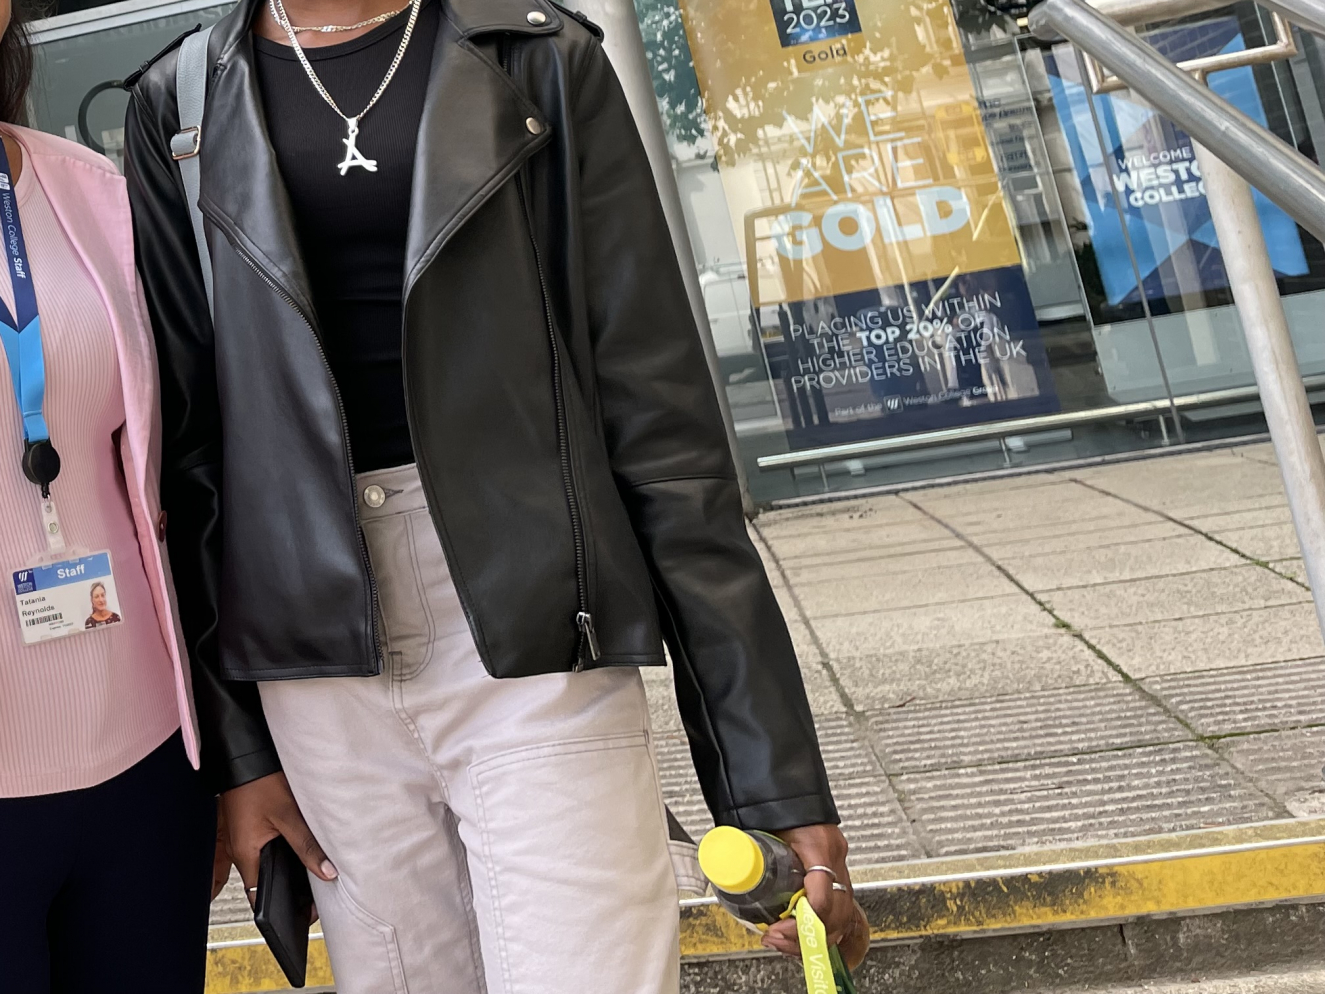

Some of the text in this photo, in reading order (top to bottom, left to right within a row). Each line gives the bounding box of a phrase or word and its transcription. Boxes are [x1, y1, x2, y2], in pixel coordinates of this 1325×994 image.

[784, 2, 849, 34] 2023
[803, 44, 847, 64] Gold
[783, 91, 905, 153] WE
[791, 137, 933, 207] ARE
[1113, 160, 1201, 192] WEST
[1118, 146, 1192, 169] WELCOME
[1129, 180, 1206, 207] COLLE
[2, 192, 26, 279] Weston College Staff
[771, 186, 970, 260] GOLD
[791, 292, 1002, 341] PLACING US WITHIN
[809, 313, 987, 355] THE TOP 20% OF
[791, 340, 1028, 393] PROVIDERS IN THE UK
[798, 326, 1011, 374] HIGHER EDUCATION
[57, 564, 85, 579] Staff
[21, 604, 55, 617] Reynolds
[800, 903, 818, 948] llege
